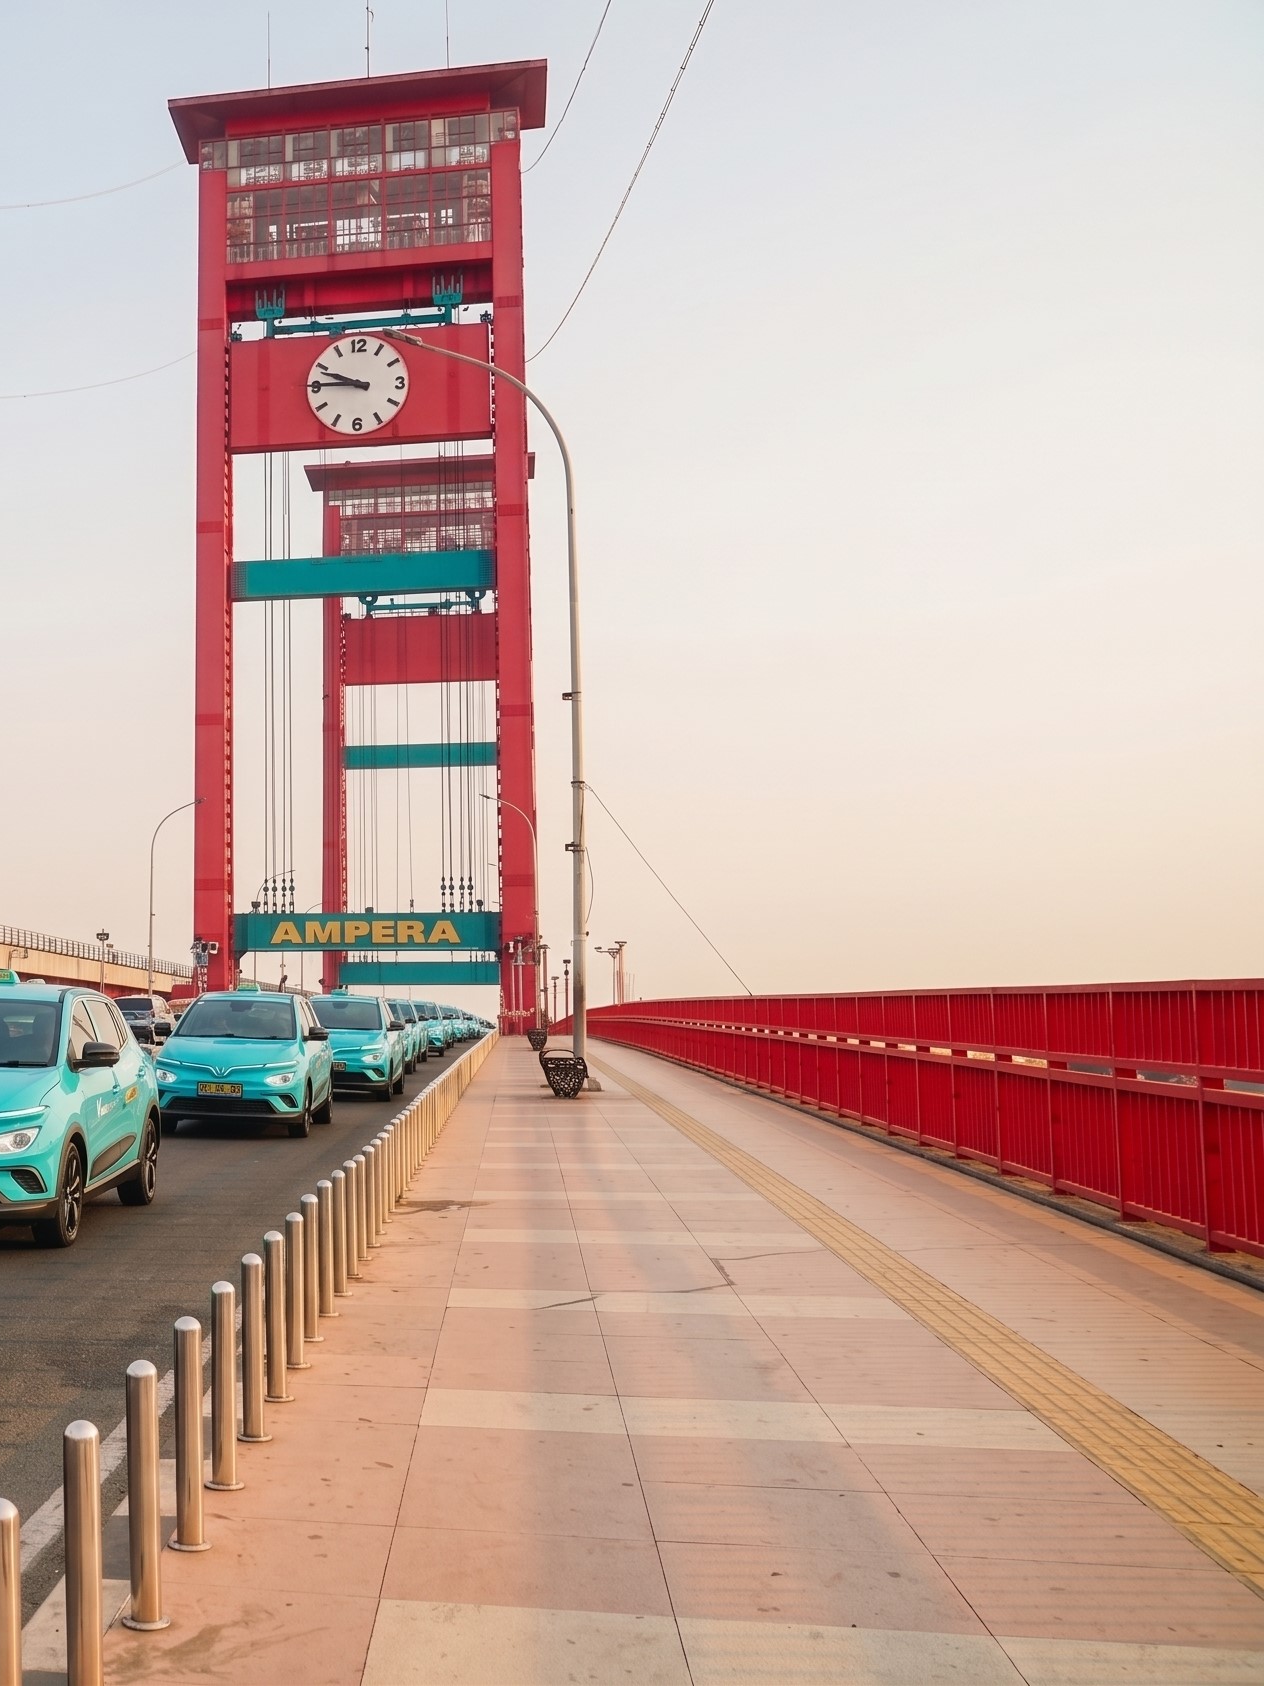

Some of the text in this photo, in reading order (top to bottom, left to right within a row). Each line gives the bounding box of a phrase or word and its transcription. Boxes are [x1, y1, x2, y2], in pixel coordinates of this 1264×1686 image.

[350, 338, 367, 353] 12
[311, 380, 322, 394] 9
[394, 376, 406, 390] 3
[351, 417, 363, 432] 6
[270, 920, 461, 945] AMPERA
